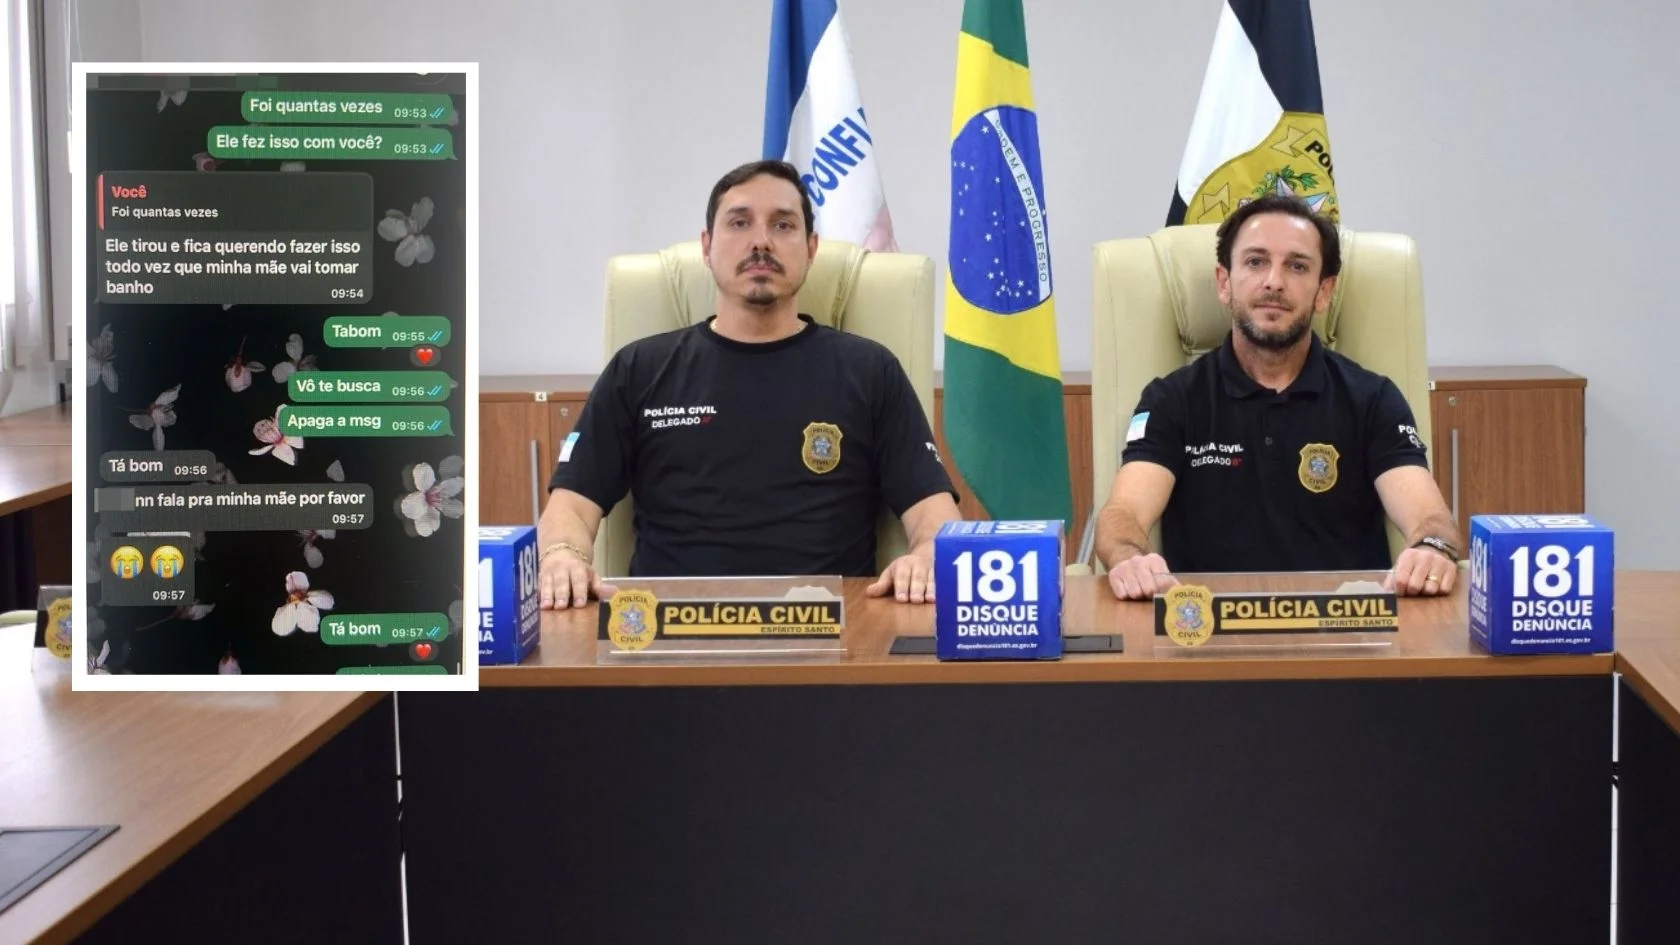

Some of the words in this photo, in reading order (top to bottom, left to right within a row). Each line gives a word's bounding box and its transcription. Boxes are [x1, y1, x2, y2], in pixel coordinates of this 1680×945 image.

[801, 107, 872, 207] CONFI
[1016, 173, 1026, 183] E
[1022, 187, 1047, 283] PROGRESSO
[644, 406, 685, 417] POLÍCIA
[688, 406, 717, 414] CIVIL
[652, 417, 701, 428] DELEGADO
[1218, 443, 1244, 453] CIVIL
[1191, 456, 1231, 467] DELEGADO
[952, 550, 1039, 603] 181
[1509, 545, 1594, 597] 181
[664, 602, 762, 623] POLÍCIA
[770, 606, 835, 623] CIVIL
[957, 604, 1039, 622] DISQUE
[1220, 597, 1320, 618] POLÍCIA
[1327, 599, 1392, 616] CIVIL
[1511, 600, 1593, 618] DISQUE
[761, 625, 802, 633] ESPÍRITO
[957, 622, 1039, 637] DENÚNCIA
[1318, 619, 1360, 627] ESPÍRITO
[1363, 618, 1393, 626] SANTO
[1512, 617, 1592, 632] DENÚNCIA
